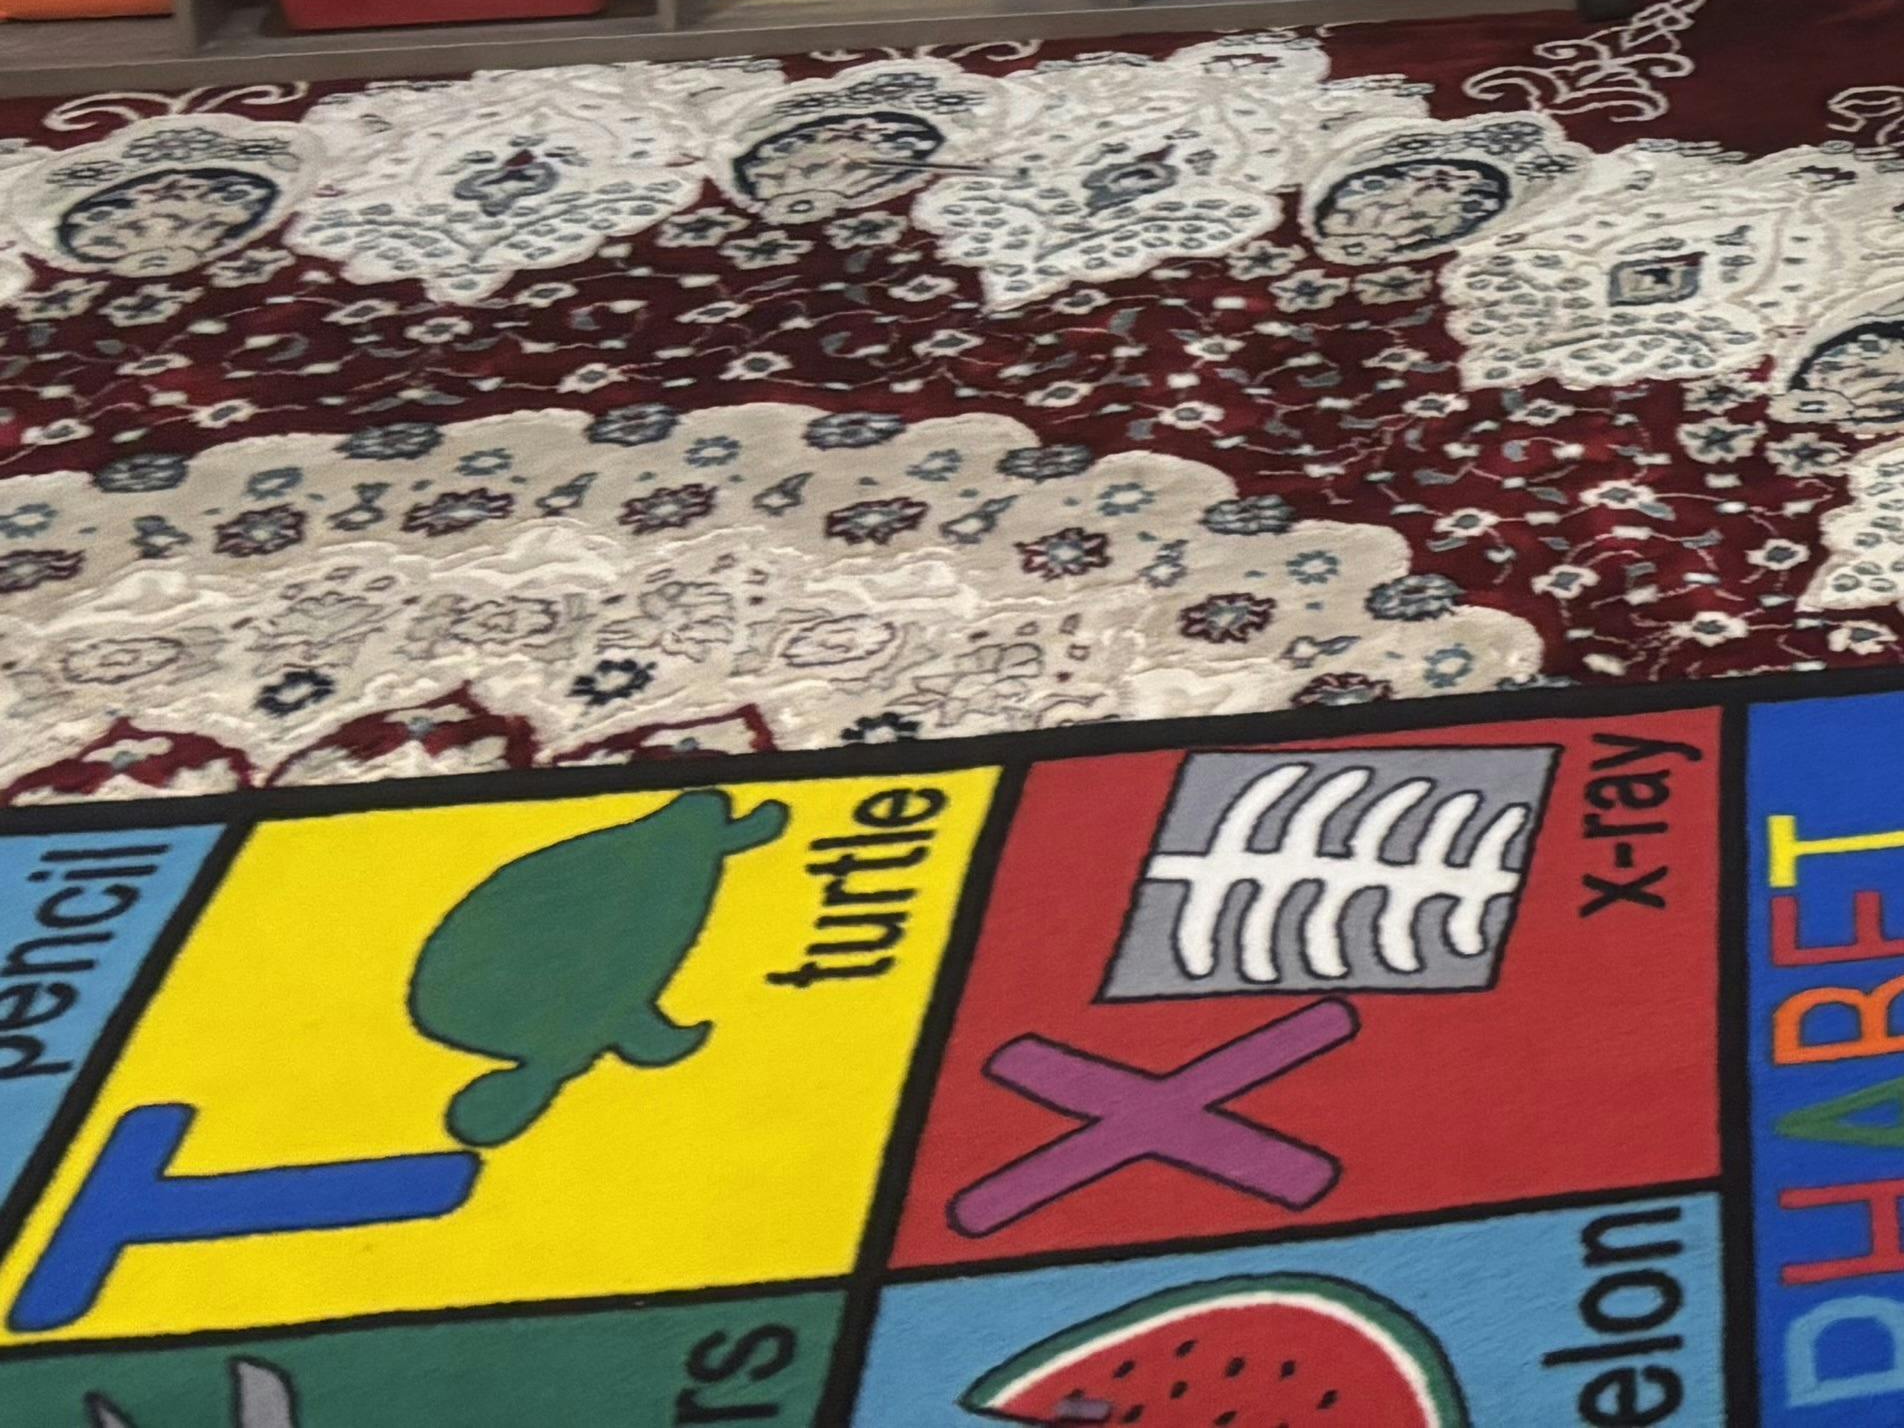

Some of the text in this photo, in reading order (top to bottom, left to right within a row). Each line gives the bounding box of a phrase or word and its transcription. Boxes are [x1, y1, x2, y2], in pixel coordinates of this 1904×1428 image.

[765, 787, 946, 988] turtle
[1579, 732, 1704, 918] x-ray
[6, 1102, 482, 1333] T
[946, 996, 1361, 1238] X
